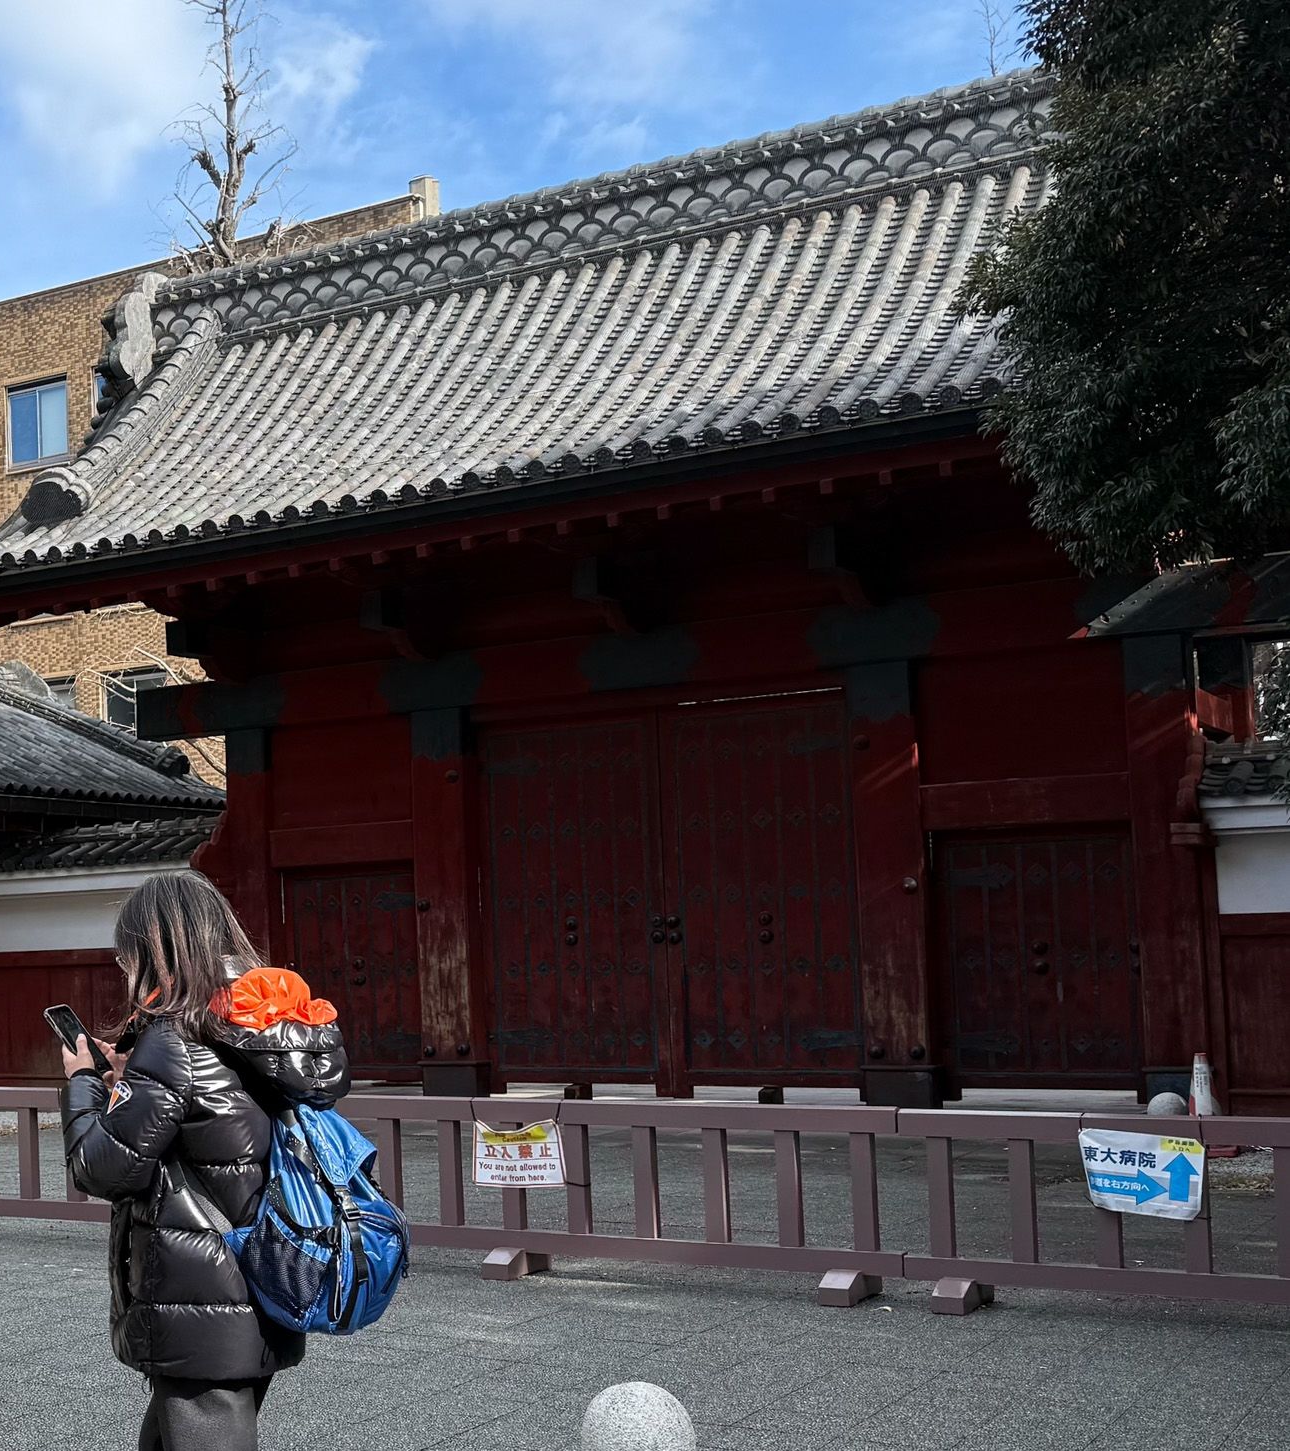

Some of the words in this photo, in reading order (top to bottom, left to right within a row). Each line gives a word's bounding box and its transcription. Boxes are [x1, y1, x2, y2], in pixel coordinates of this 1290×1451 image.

[484, 1143, 552, 1158] 立入禁止
[1083, 1145, 1156, 1168] 東大病院
[479, 1161, 493, 1170] You
[505, 1164, 517, 1172] not
[519, 1162, 547, 1171] allowed
[509, 1173, 525, 1181] from
[528, 1173, 547, 1181] here.
